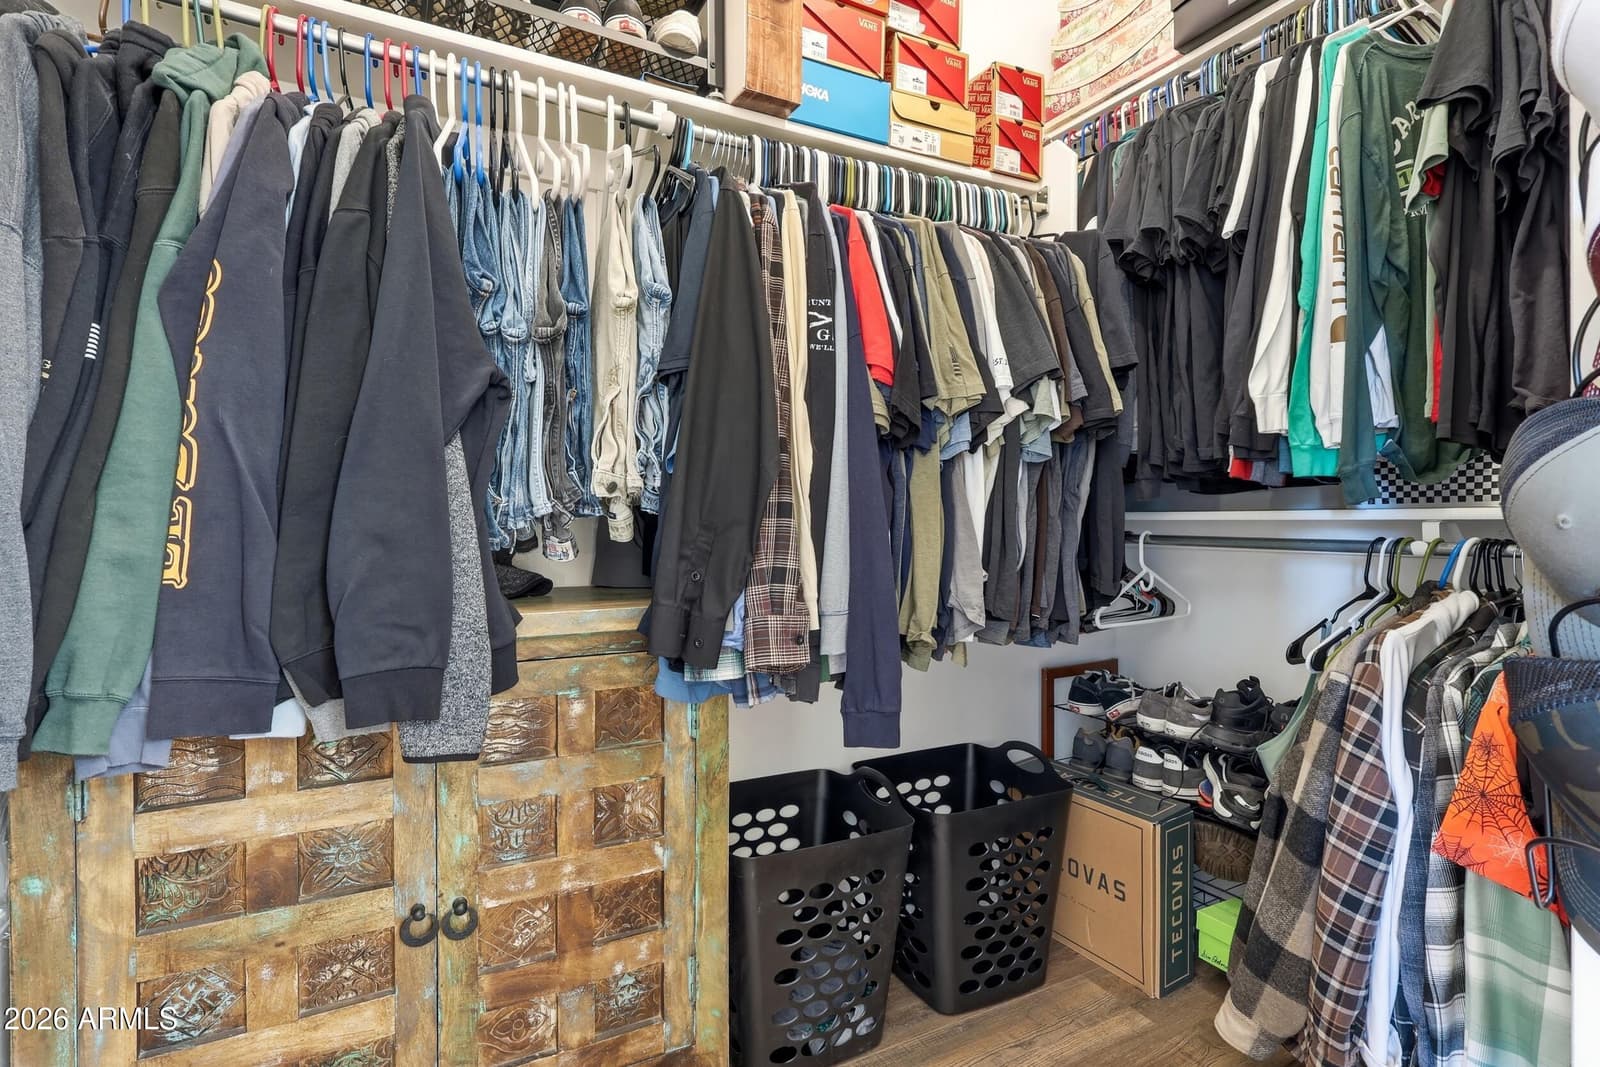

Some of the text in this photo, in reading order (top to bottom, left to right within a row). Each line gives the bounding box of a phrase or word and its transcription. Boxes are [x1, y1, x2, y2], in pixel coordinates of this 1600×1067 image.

[858, 17, 878, 32] VANS
[945, 56, 962, 69] VANS
[1023, 75, 1039, 88] VANS
[1022, 128, 1037, 141] VANS
[808, 298, 832, 306] UNT
[1061, 857, 1126, 902] OVAS
[1171, 844, 1184, 963] TECOVAS
